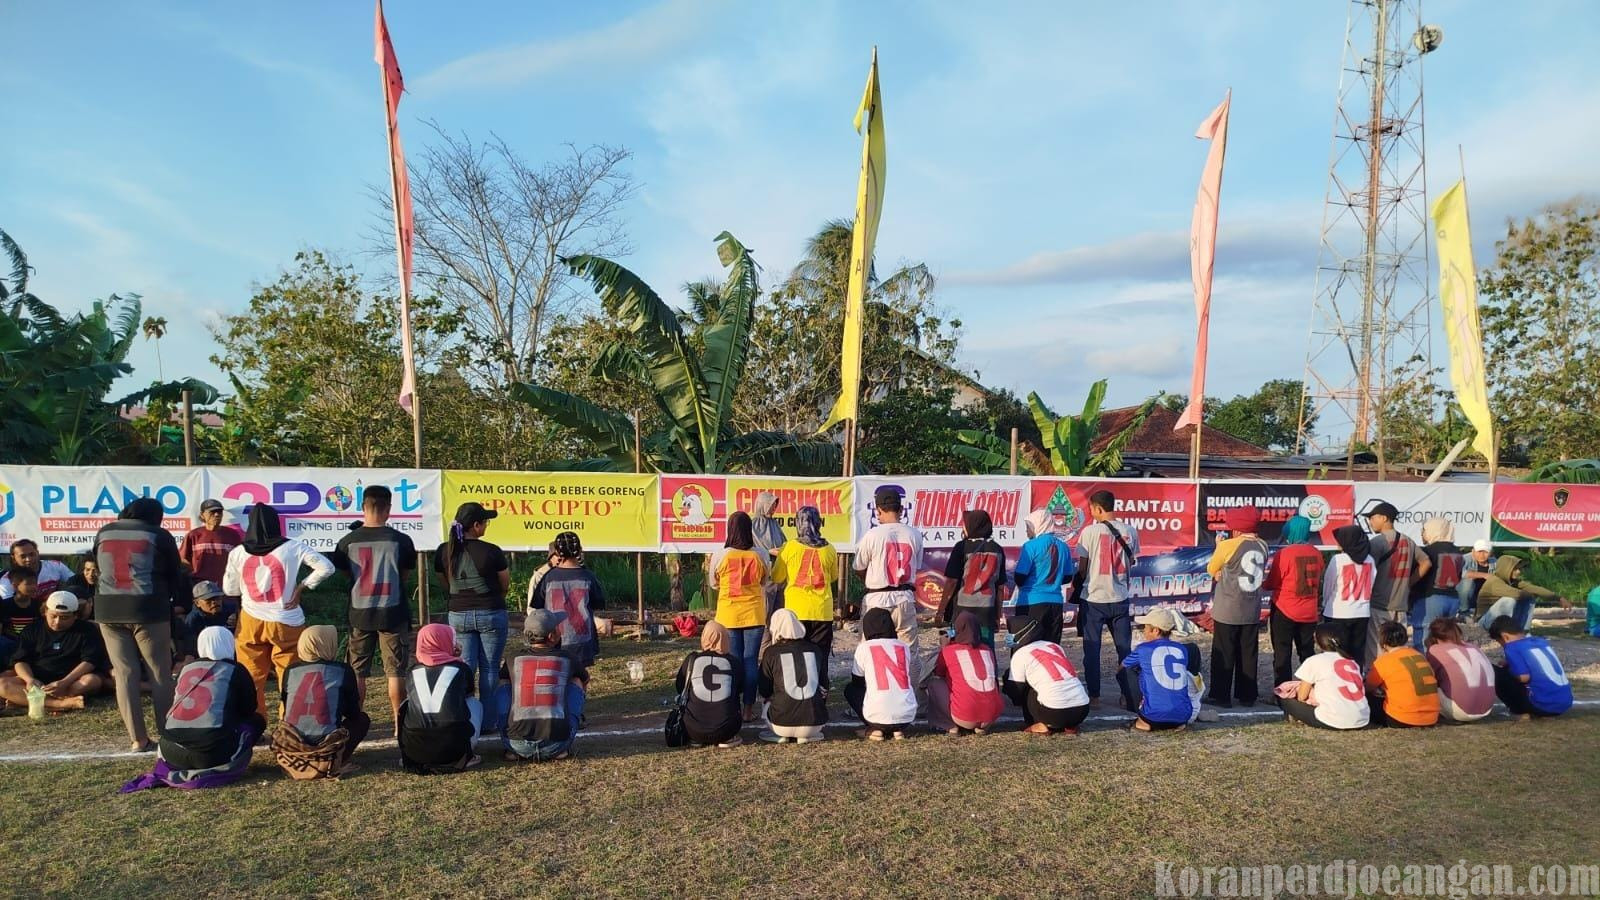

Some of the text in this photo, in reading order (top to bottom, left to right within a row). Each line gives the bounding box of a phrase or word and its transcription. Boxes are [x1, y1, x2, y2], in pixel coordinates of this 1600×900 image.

[42, 485, 187, 515] PLANO
[459, 485, 645, 497] AYAM GORENG & BEBEK GORENG
[1206, 496, 1253, 507] RUMAH
[1255, 497, 1300, 508] MAKAN
[524, 520, 585, 531] WONOGIRI
[1260, 509, 1296, 522] ALEX
[1396, 511, 1485, 525] PRODUCTION
[1498, 511, 1532, 521] GAJAH
[1534, 511, 1585, 521] MUNGKUR
[1536, 523, 1583, 533] JAKARTA
[44, 535, 70, 544] DEPAN
[101, 540, 147, 590] T
[242, 554, 287, 603] O
[357, 546, 392, 597] L
[794, 549, 826, 592] A
[885, 543, 913, 586] B
[964, 552, 998, 595] R
[1238, 550, 1265, 592] S
[1295, 556, 1320, 597] E
[1342, 562, 1372, 601] M
[520, 659, 562, 707] E
[690, 655, 732, 703] G
[780, 651, 820, 701] U
[870, 645, 910, 691] N
[954, 649, 996, 692] U
[1030, 643, 1077, 682] N
[1150, 645, 1189, 692] G
[1333, 658, 1365, 702] S
[1401, 653, 1438, 697] E
[1529, 645, 1570, 687] U
[171, 667, 214, 722] S
[287, 671, 332, 726] A
[412, 666, 460, 714] V
